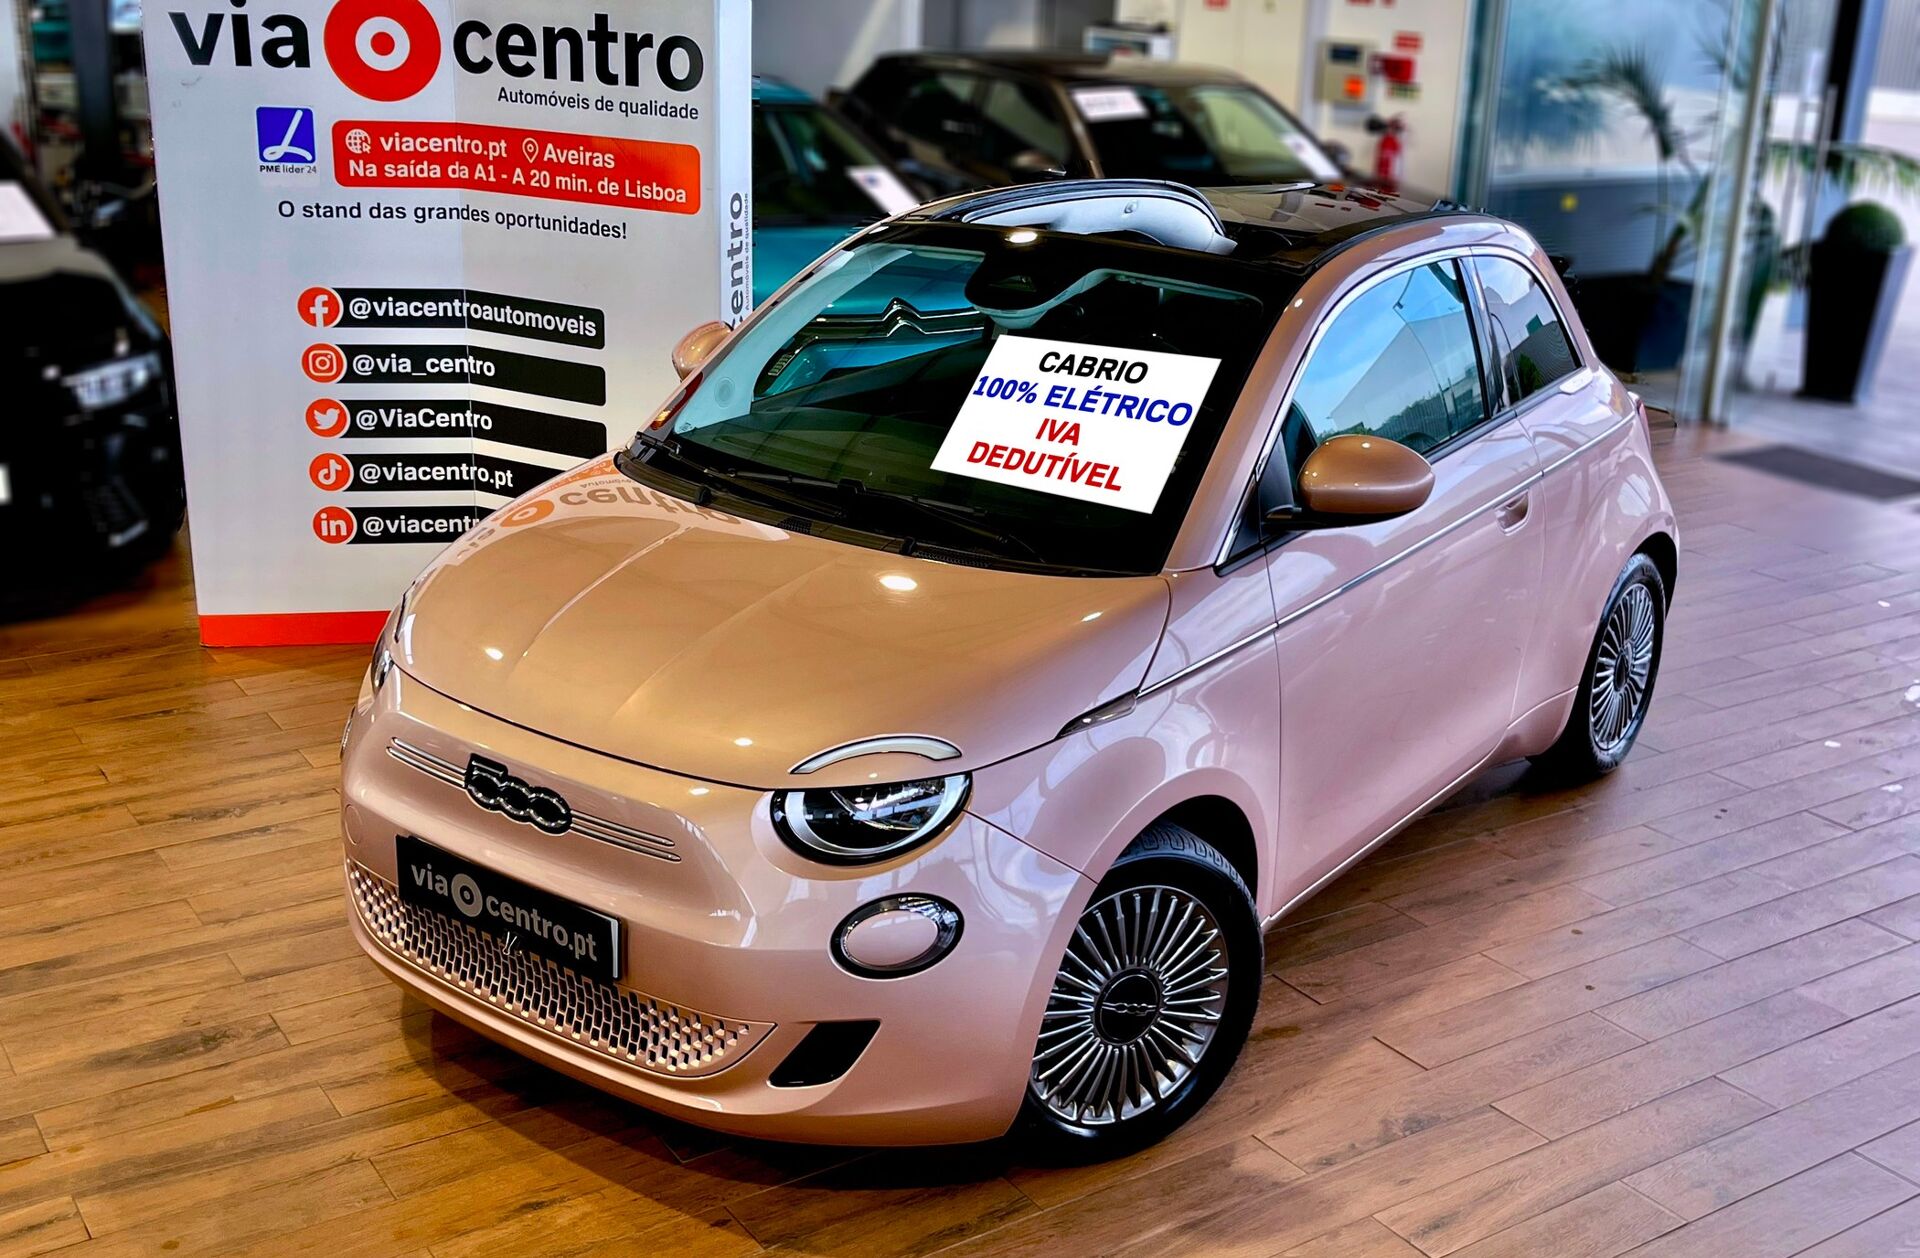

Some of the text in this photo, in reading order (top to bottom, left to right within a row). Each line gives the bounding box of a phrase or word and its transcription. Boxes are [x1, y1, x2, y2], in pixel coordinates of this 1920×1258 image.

[168, 0, 705, 92] via centro
[497, 86, 699, 120] Automóveis de qualidade
[259, 164, 281, 173] PME
[379, 132, 616, 169] viacentro.pt Aveiras
[349, 159, 378, 177] Na
[384, 159, 441, 178] saída
[447, 161, 469, 179] da
[474, 163, 496, 182] A1
[512, 167, 526, 186] A
[530, 169, 550, 188] 20
[555, 173, 593, 193] min.
[597, 177, 620, 196] de
[625, 180, 687, 204] Lisboa
[278, 200, 627, 240] O stand das grandes oportunidades!
[349, 297, 597, 337] @viacentroautomoveis
[352, 353, 496, 377] @via_centro
[1038, 351, 1149, 384] CABRIO
[355, 408, 493, 431] @ViaCentro
[972, 375, 1193, 427] 100% ELÉTRICO
[1035, 418, 1081, 446] IVA
[359, 462, 514, 490] @viacentro.pt
[966, 441, 1123, 492] DEDUTÍVEL
[465, 753, 573, 835] 500
[410, 863, 598, 962] via centro.pt
